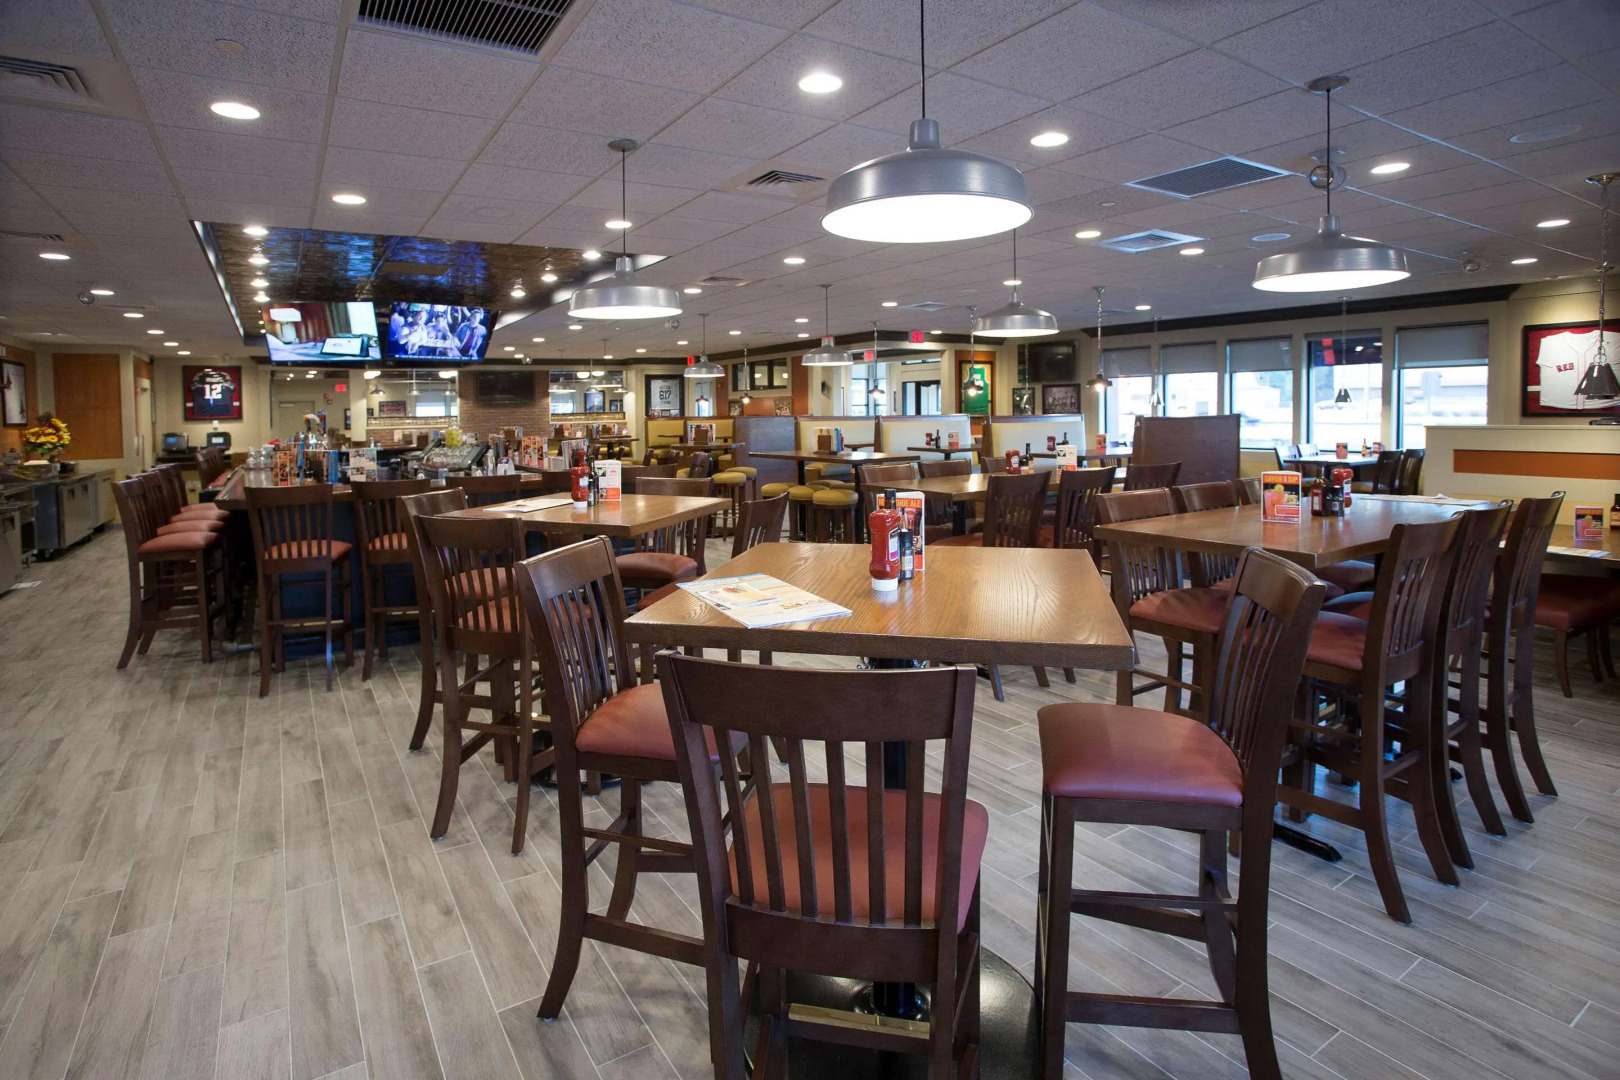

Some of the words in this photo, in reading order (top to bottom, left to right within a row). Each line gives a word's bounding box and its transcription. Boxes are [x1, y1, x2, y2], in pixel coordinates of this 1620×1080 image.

[204, 384, 222, 399] 12
[659, 390, 672, 400] 617
[910, 499, 921, 508] ALE
